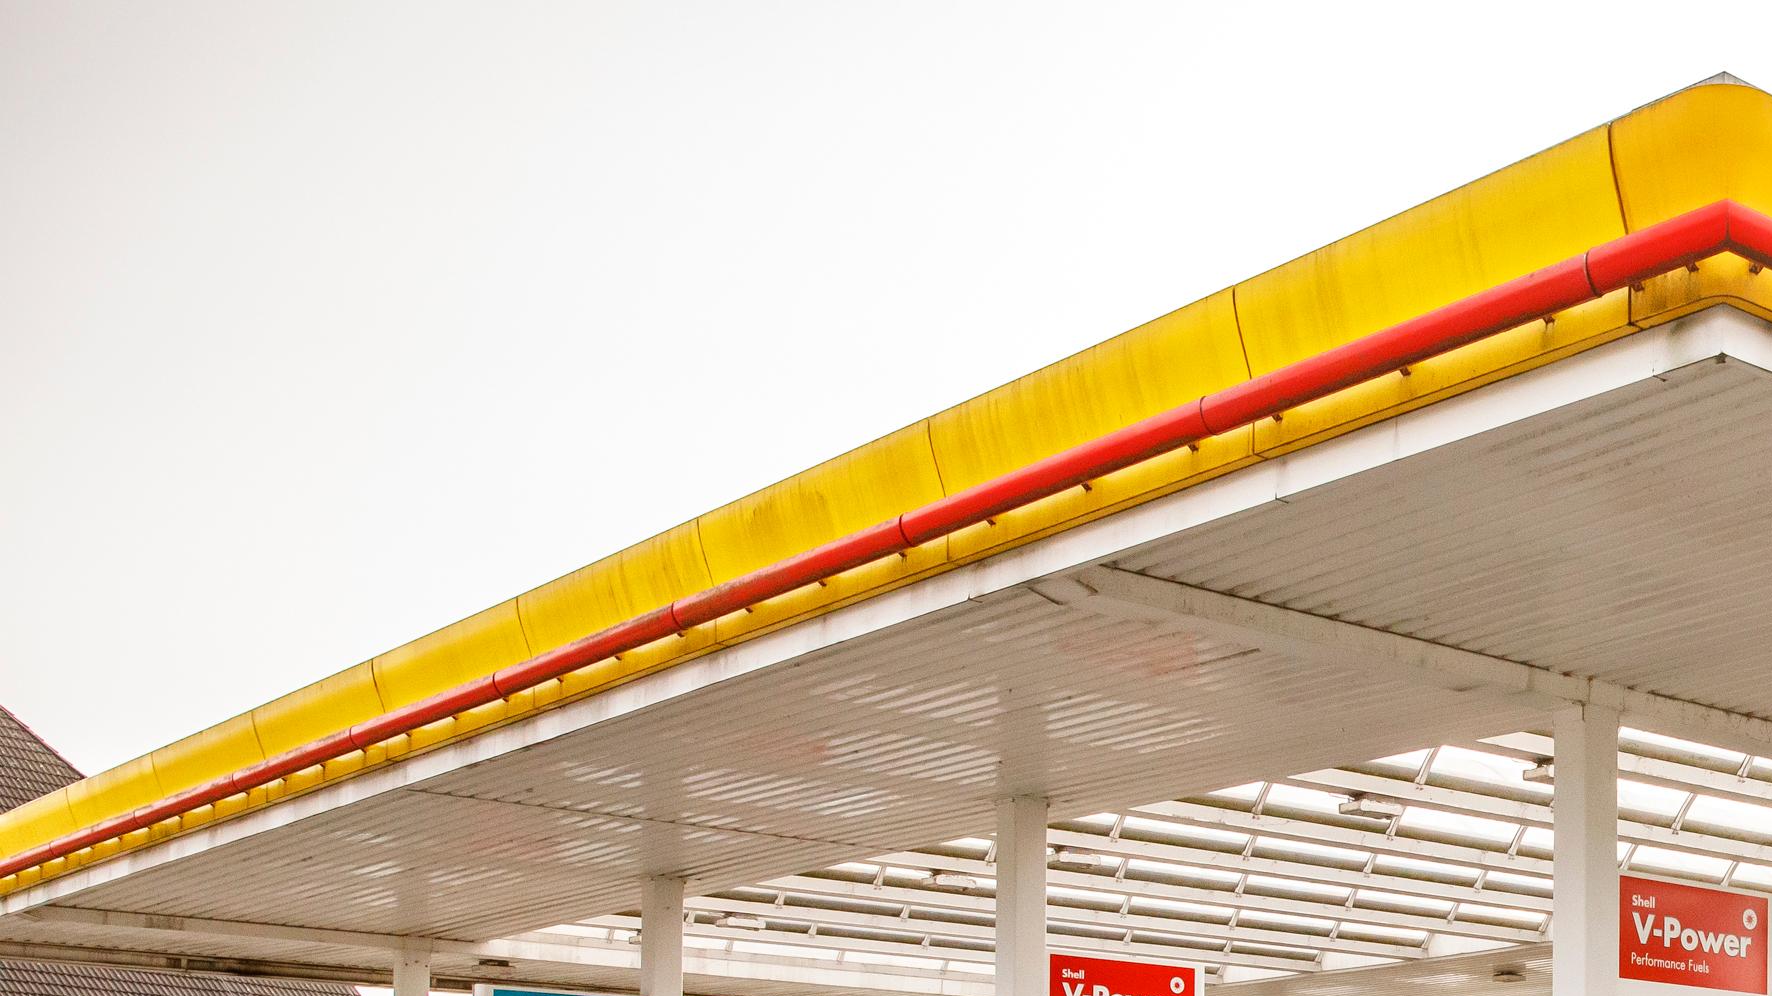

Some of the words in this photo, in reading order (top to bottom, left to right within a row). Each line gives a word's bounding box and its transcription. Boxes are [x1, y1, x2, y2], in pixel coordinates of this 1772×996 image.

[1632, 895, 1656, 909] Shell
[1632, 912, 1751, 958] V-Power
[1631, 952, 1685, 971] Performance
[1688, 959, 1709, 974] Fuels
[1062, 968, 1085, 979] Shell
